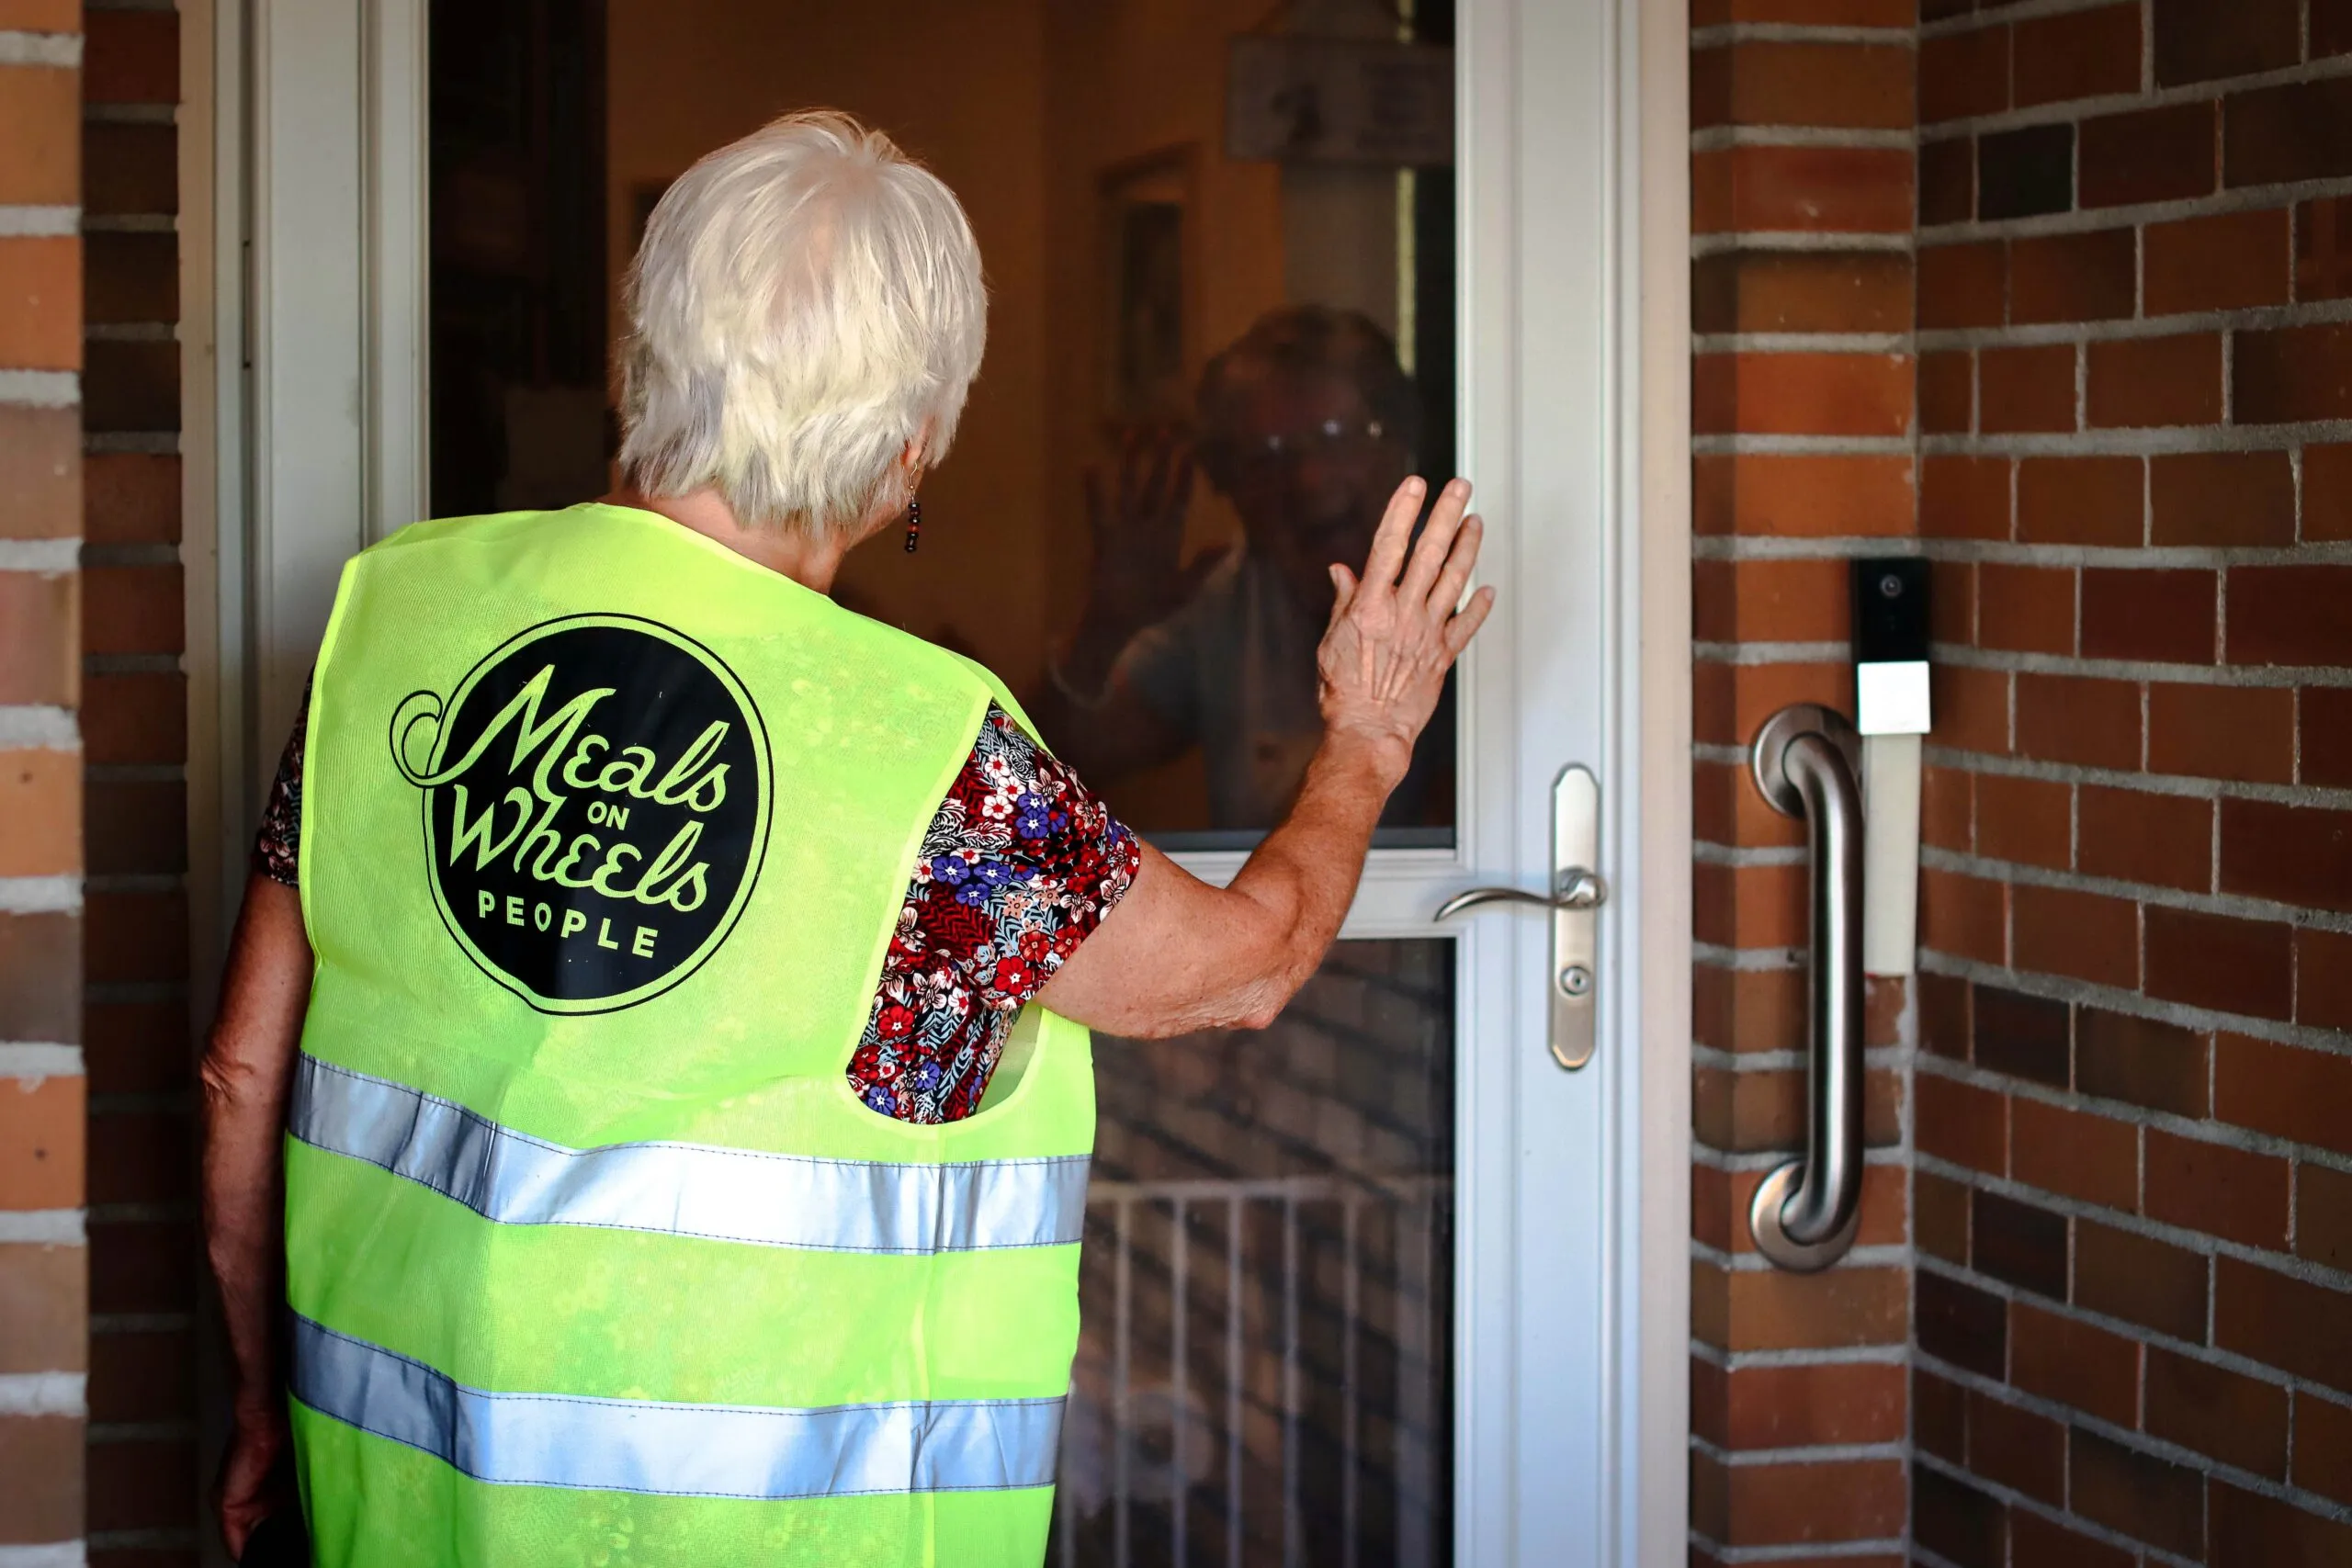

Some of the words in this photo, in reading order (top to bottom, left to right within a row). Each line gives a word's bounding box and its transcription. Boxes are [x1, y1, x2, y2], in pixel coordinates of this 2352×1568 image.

[429, 664, 730, 812] Meals
[450, 784, 711, 912] Wheels
[587, 800, 630, 830] ON
[478, 889, 659, 959] PEOPLE
